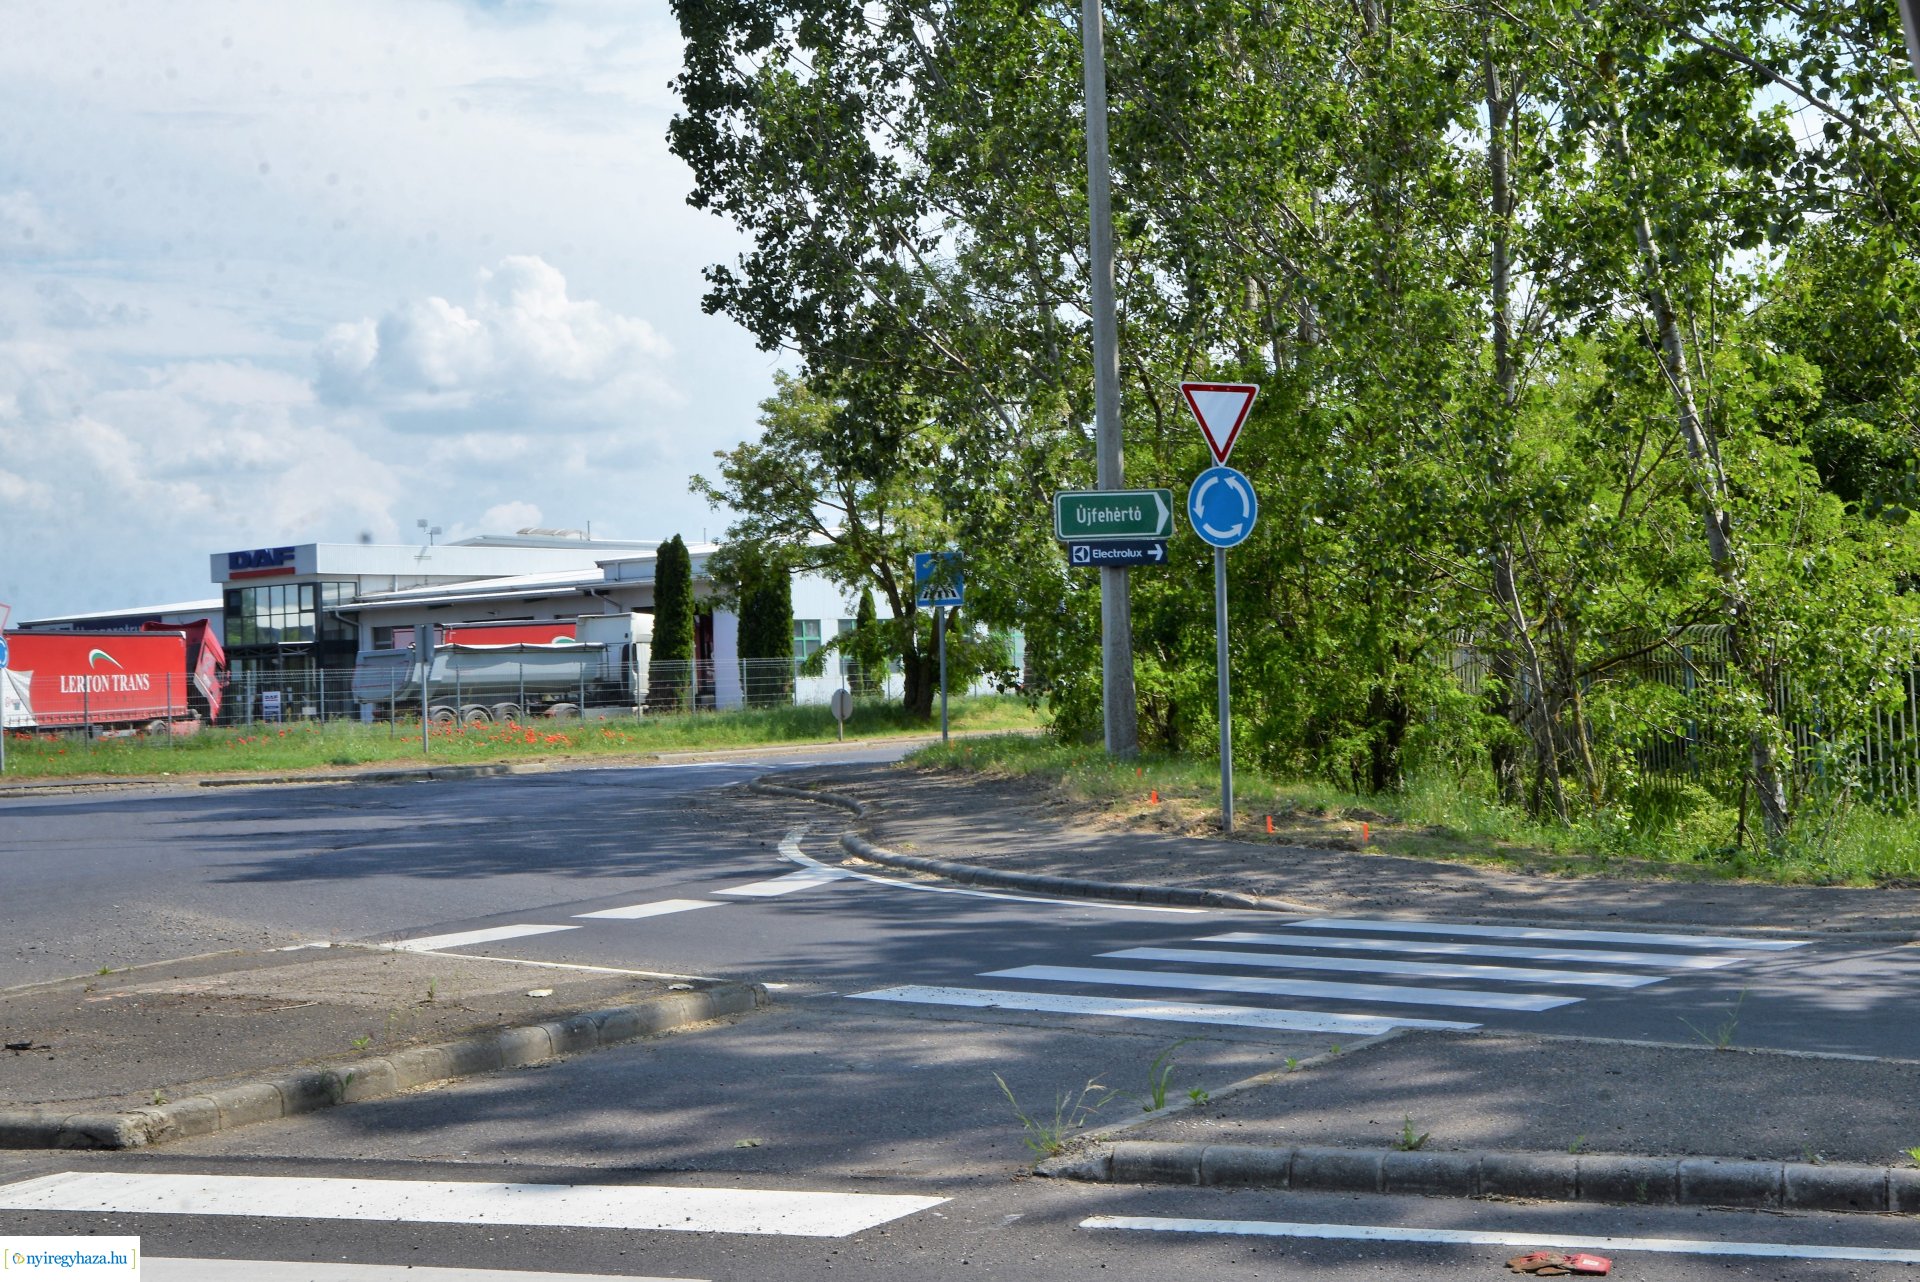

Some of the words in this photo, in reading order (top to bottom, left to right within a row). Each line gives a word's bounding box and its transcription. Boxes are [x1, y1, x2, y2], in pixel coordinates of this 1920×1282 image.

[1076, 504, 1142, 526] Újfehértó
[229, 546, 295, 570] DAF
[1092, 548, 1143, 559] Electrolux
[60, 675, 110, 693] LERTON
[111, 674, 150, 691] TRANS
